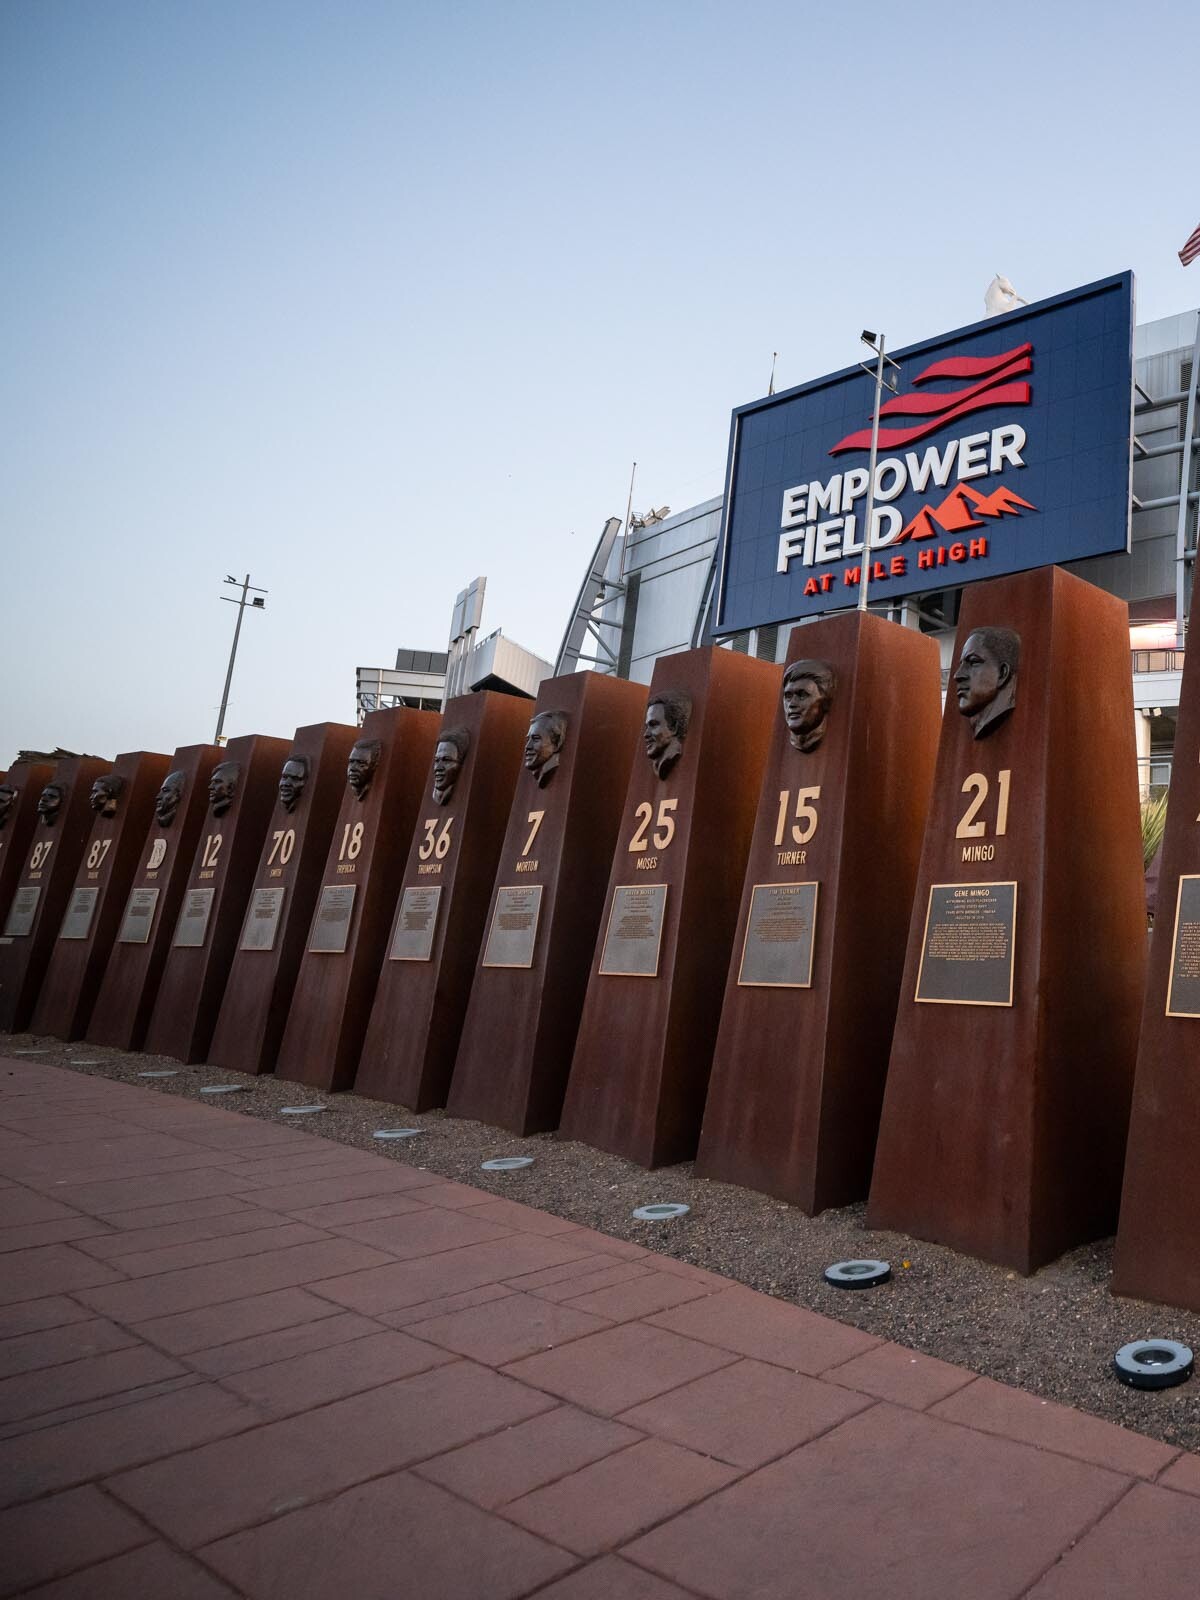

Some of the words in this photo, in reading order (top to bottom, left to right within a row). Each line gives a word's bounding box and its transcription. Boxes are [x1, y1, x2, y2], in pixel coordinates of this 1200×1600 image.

[781, 423, 1027, 528] EMPOWER
[776, 505, 904, 573] FIELD
[803, 573, 834, 595] AT
[918, 537, 988, 569] HIGH
[773, 785, 821, 846] 15
[955, 769, 1012, 839] 21
[338, 821, 365, 861] 18
[418, 816, 455, 860] 36
[521, 810, 546, 856] 7
[628, 798, 679, 852] 25
[30, 841, 53, 869] 87
[86, 839, 112, 869] 87
[201, 833, 223, 868] 12
[266, 829, 296, 866] 70
[636, 856, 658, 870] MOSES
[777, 850, 807, 866] TURNER
[961, 844, 995, 863] MINGO
[954, 889, 969, 897] GENE
[970, 889, 990, 897] MINGO
